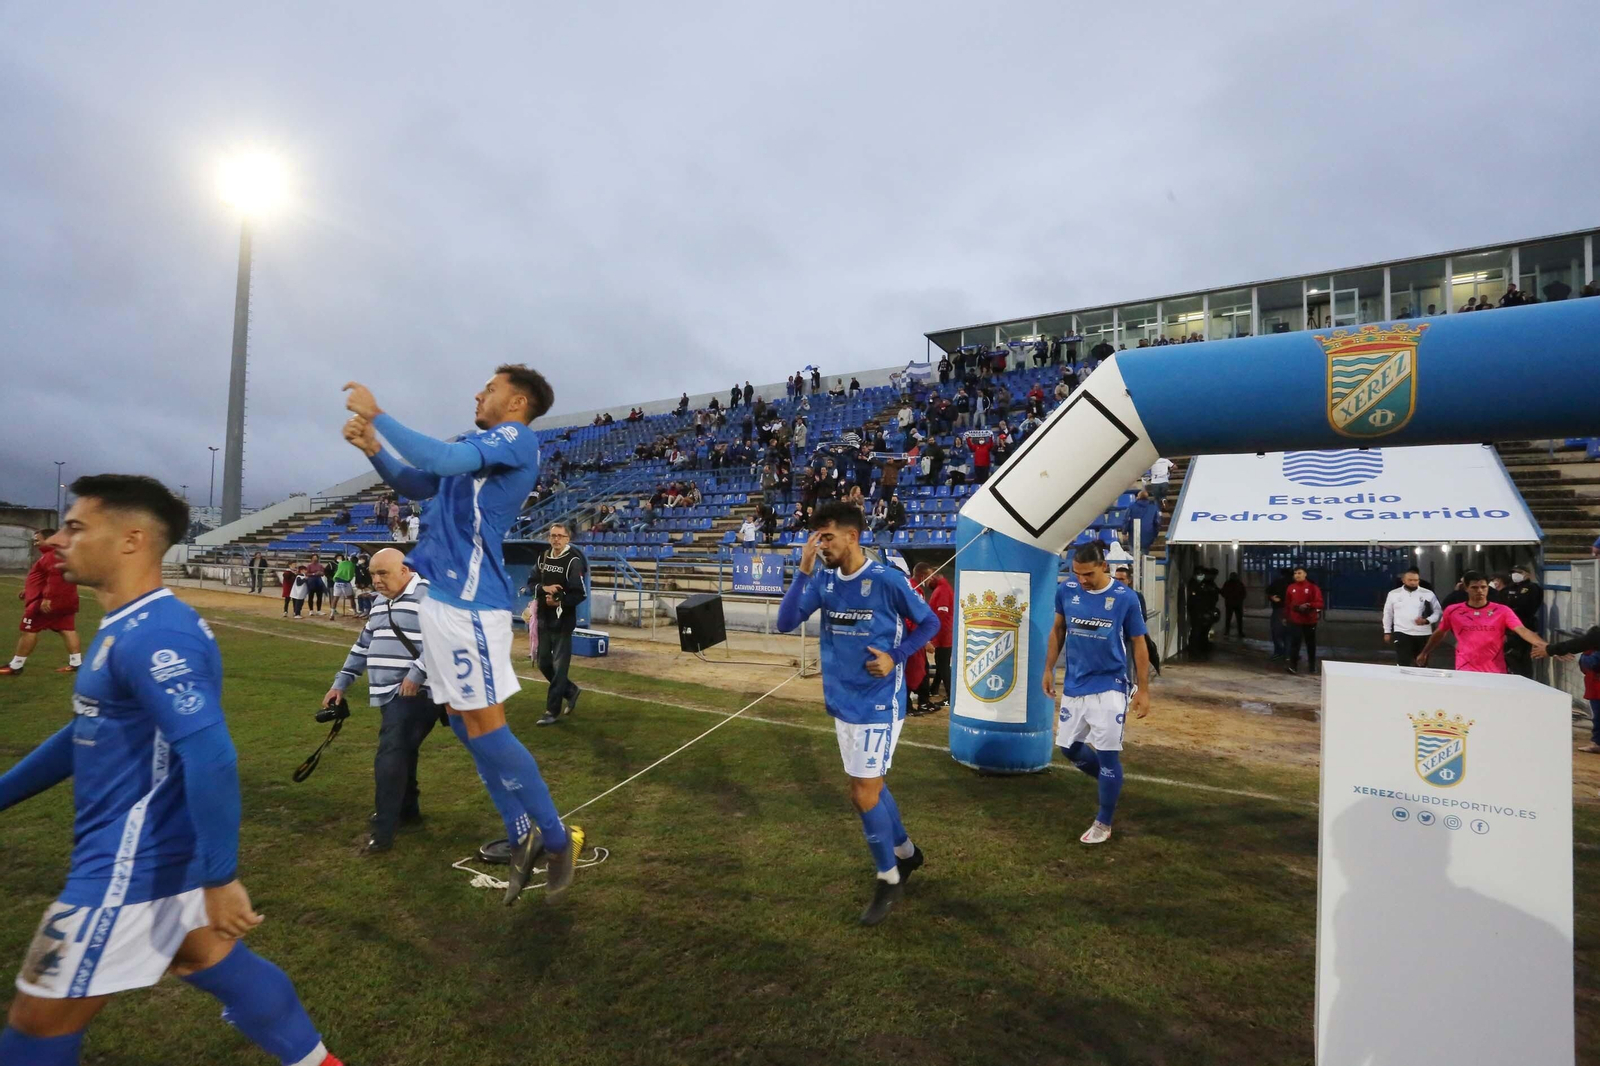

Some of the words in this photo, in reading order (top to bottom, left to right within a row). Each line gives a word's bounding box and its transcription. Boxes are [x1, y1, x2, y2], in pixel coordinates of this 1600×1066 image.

[1340, 353, 1407, 422] XEREZ
[1191, 510, 1288, 522] Pedro
[1301, 510, 1333, 522] S.
[1344, 507, 1510, 520] Garrido
[1268, 493, 1402, 505] Estadio
[1071, 616, 1113, 628] Torralva
[452, 649, 473, 680] 5
[970, 632, 1012, 681] XEREZ
[864, 728, 886, 752] 17
[1422, 740, 1461, 773] XEREZ
[1353, 785, 1537, 820] XEREZCLUBDEPORTIVO.ES
